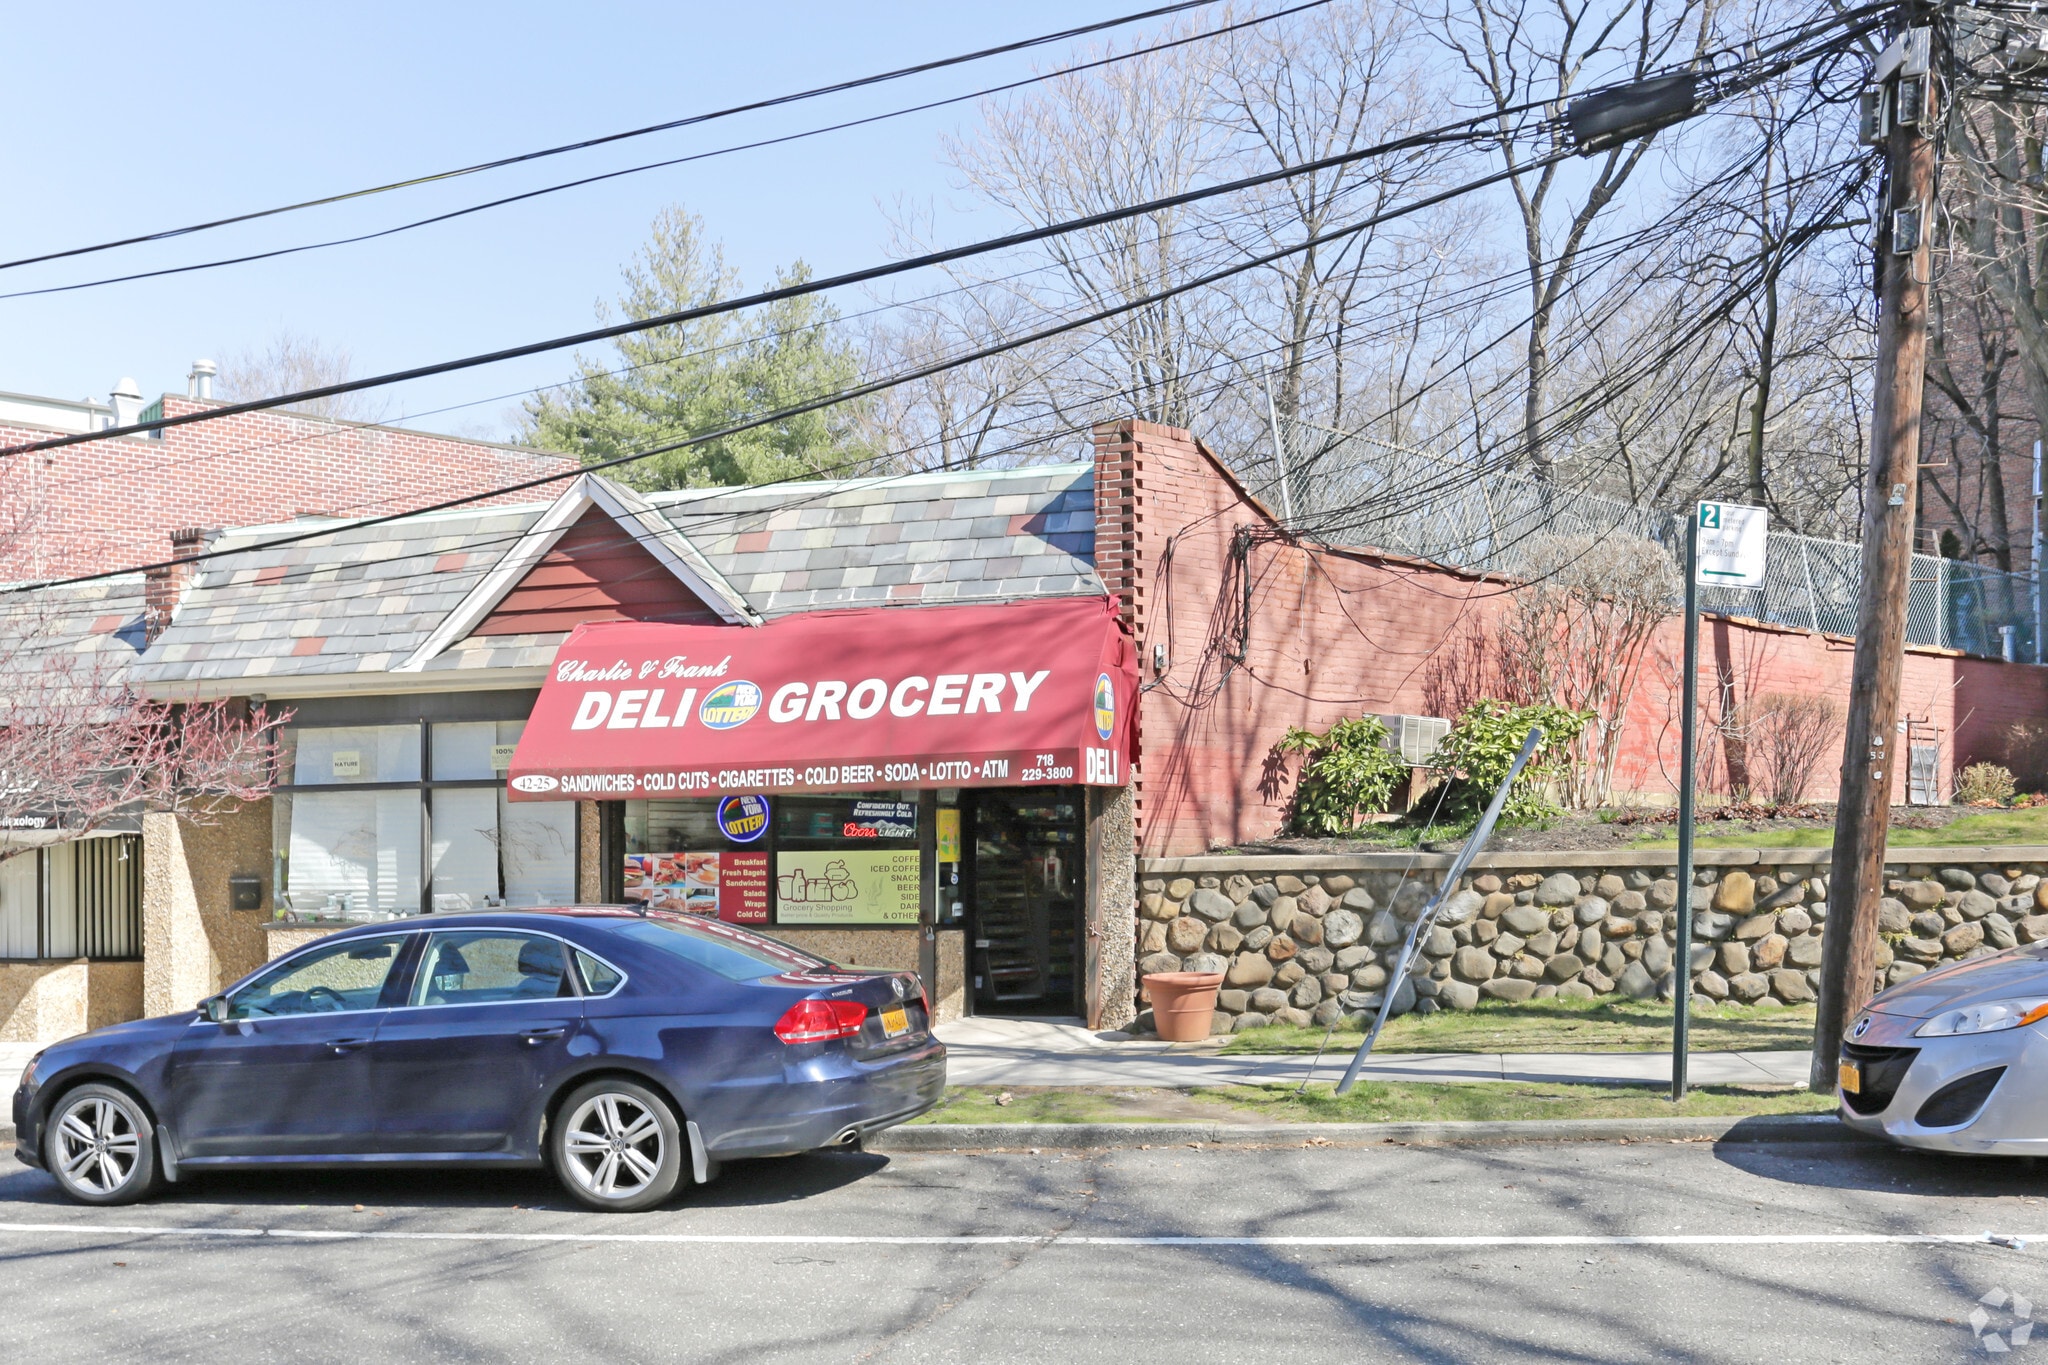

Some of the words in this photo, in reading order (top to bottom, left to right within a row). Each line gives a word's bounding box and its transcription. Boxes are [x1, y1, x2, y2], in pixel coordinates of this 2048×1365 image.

[1704, 505, 1716, 527] 2
[1702, 547, 1723, 557] Except
[556, 659, 633, 683] Charlie
[638, 660, 659, 680] &
[658, 655, 733, 680] Frank
[570, 687, 698, 730] DELI
[768, 670, 1051, 723] GROCERY
[703, 706, 756, 723] LOTTERY
[1036, 754, 1054, 767] 718
[1086, 746, 1118, 785] DELI
[519, 776, 551, 790] 42-25
[561, 773, 635, 792] SANDWICHES
[643, 772, 676, 790] COLD
[678, 771, 710, 789] CUTS
[718, 768, 795, 788] CIGARETTES
[805, 766, 839, 786] COLD
[841, 764, 874, 784] BEER
[885, 762, 920, 782] SODA
[929, 761, 971, 780] LOTTO
[981, 759, 1009, 778] ATM
[1021, 766, 1073, 781] 229-3800
[743, 803, 763, 817] YORK
[725, 813, 765, 835] LOTTERY
[843, 822, 878, 838] Coors
[878, 828, 912, 838] LIGHT
[743, 869, 766, 878] Bagels
[725, 879, 766, 887] Sandwiches
[744, 900, 766, 909] Wraps
[783, 903, 813, 913] Grocery
[815, 903, 853, 913] Shopping
[736, 910, 752, 918] Cold
[754, 910, 767, 918] Cut
